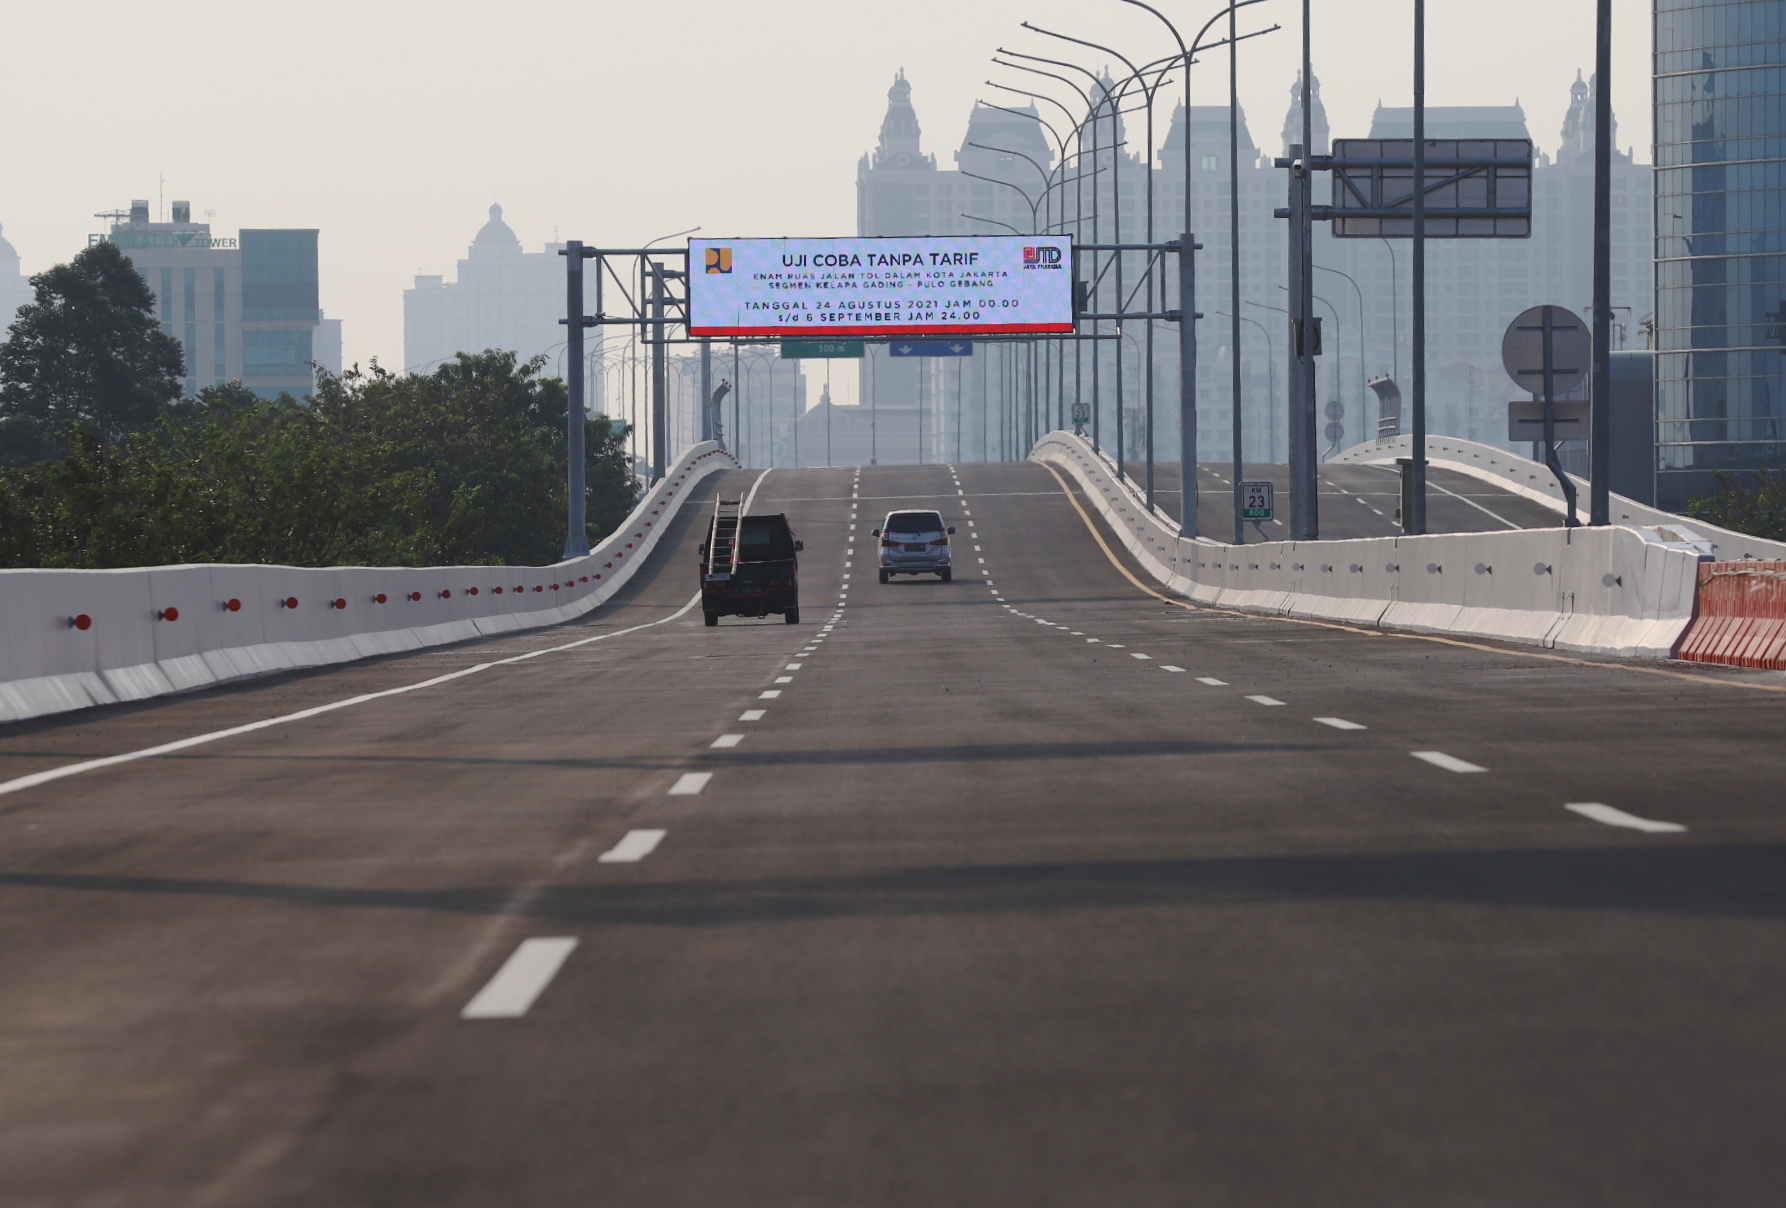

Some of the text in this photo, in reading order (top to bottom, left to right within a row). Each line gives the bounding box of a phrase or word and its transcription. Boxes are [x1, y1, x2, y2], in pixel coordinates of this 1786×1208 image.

[196, 238, 237, 248] TOWER
[782, 252, 979, 267] UJI COBA TANPA TARIF
[885, 271, 921, 279] DALAM
[816, 281, 858, 289] KELAPA
[950, 280, 994, 288] GEBANG
[744, 299, 1019, 310] TANGGAL 24 AGUSTUS 2021 JAM 00.00
[778, 311, 980, 323] s/d 6 SEPTEMBER JAM 24.00
[818, 344, 835, 353] 500
[1248, 495, 1265, 508] 23
